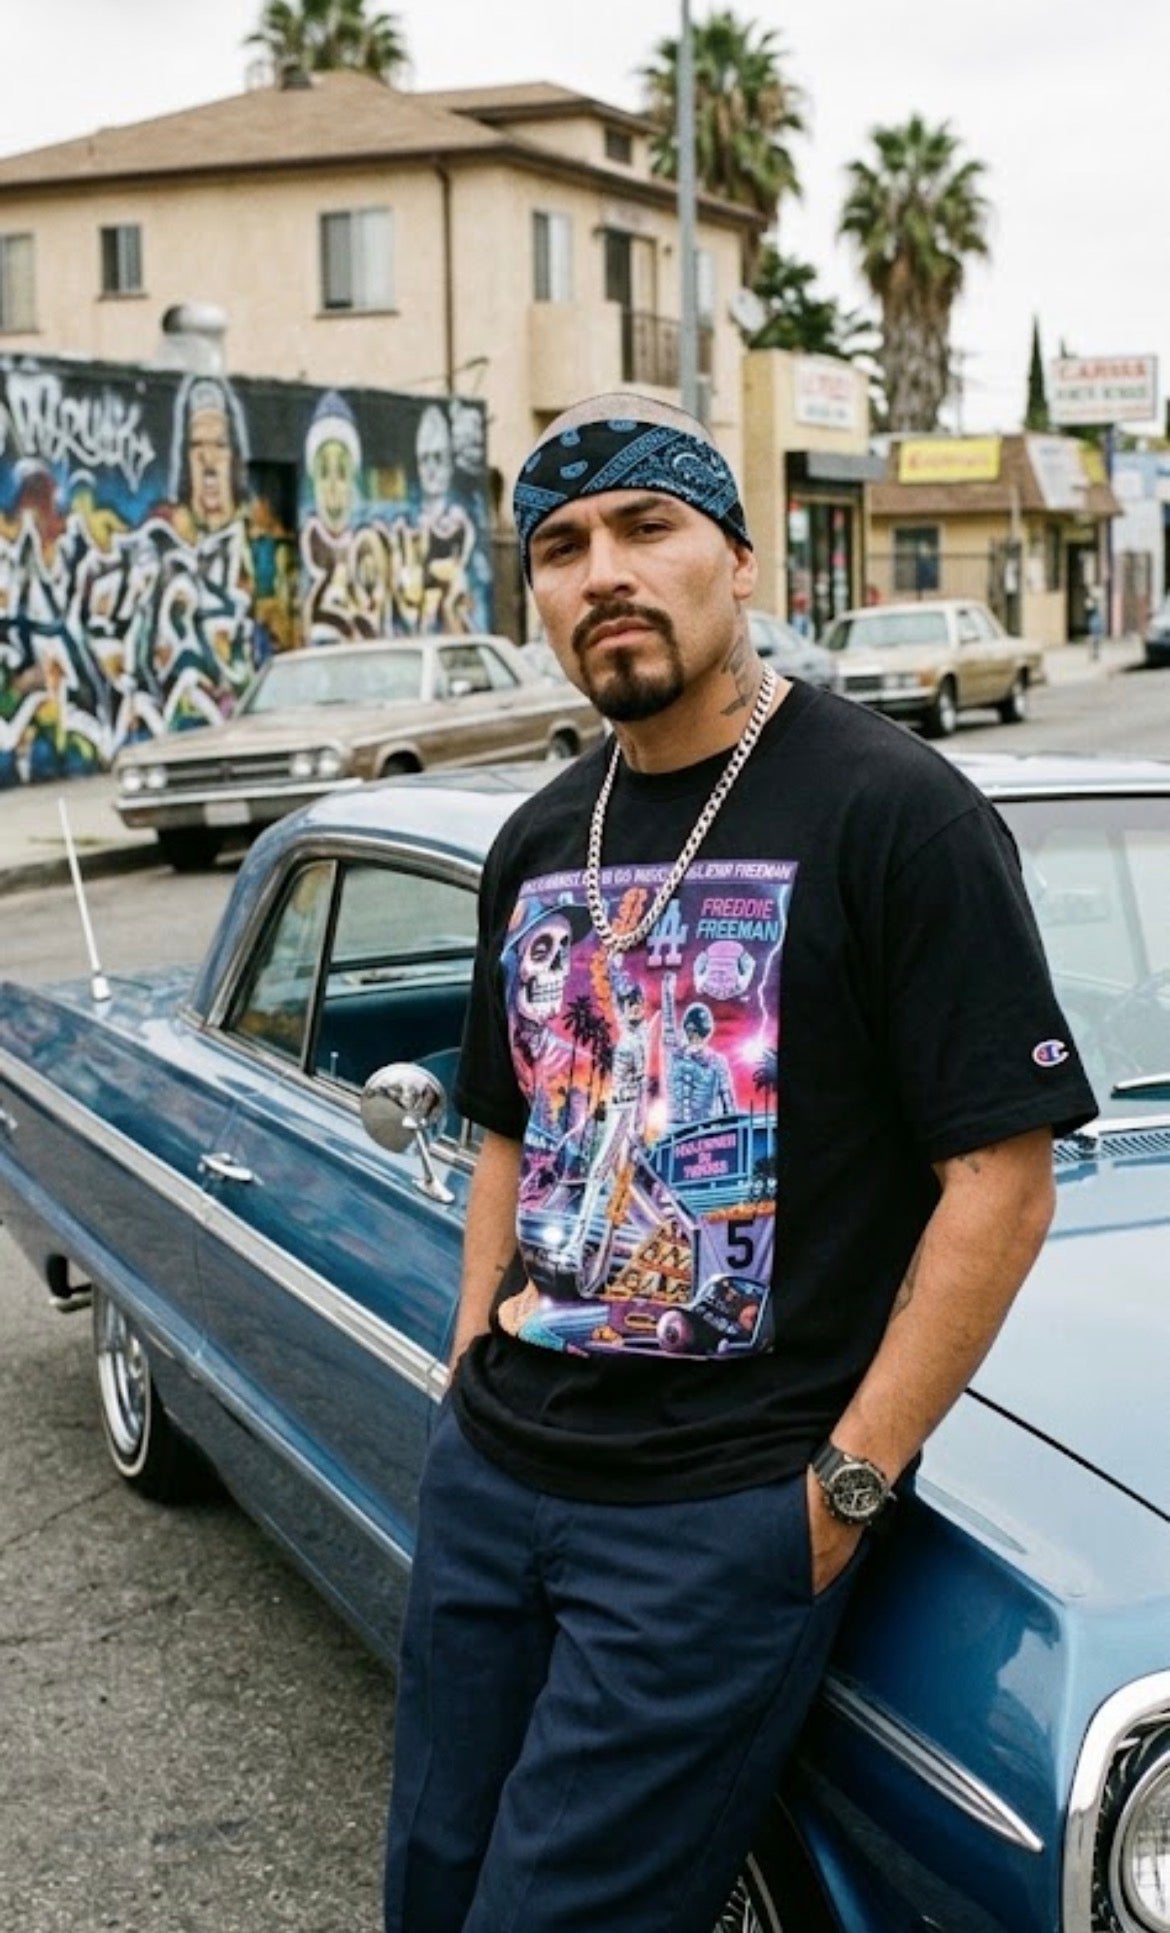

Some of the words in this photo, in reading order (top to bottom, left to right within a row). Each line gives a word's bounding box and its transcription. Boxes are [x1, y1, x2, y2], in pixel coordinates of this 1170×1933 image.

[700, 898, 775, 920] FREDDIE
[695, 919, 779, 942] FREEMAN
[726, 1220, 754, 1270] 5
